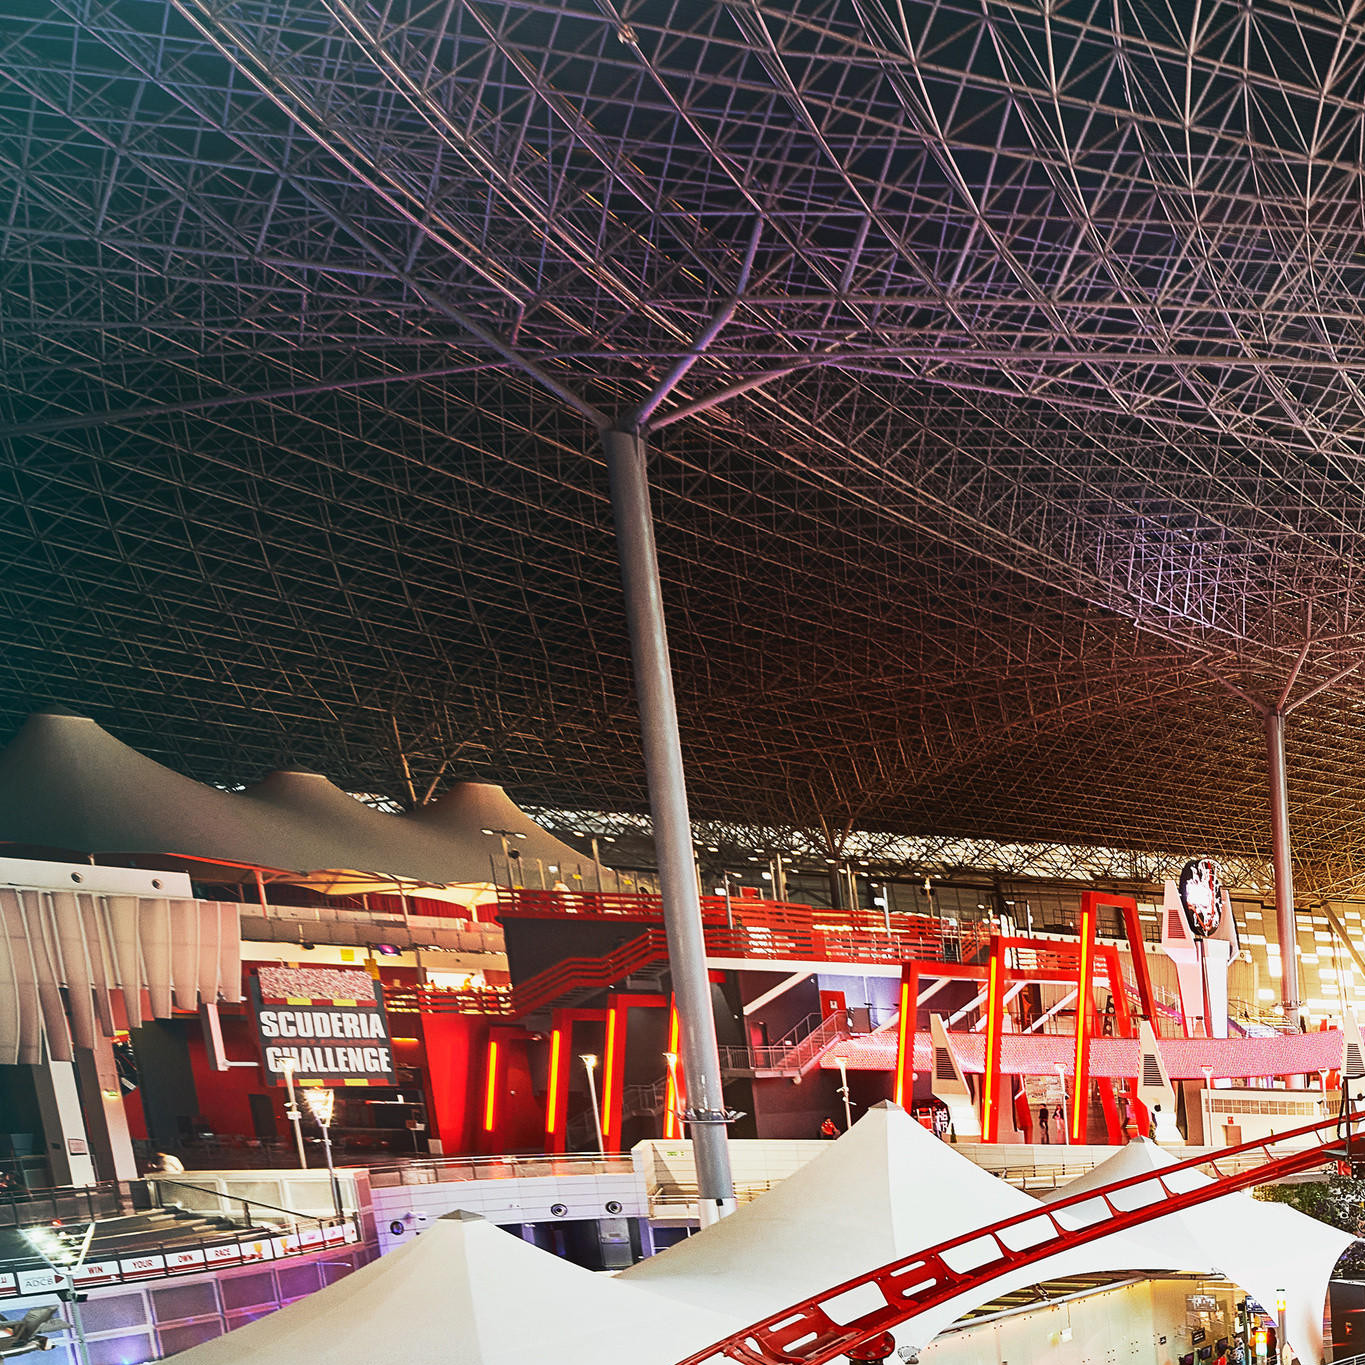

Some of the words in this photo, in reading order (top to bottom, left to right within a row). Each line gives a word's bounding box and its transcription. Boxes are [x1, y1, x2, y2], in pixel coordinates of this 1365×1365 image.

[259, 1011, 386, 1039] SCUDERIA
[265, 1047, 392, 1073] CHALLENGE
[87, 1266, 104, 1275] WIN
[133, 1259, 153, 1269] YOUR
[178, 1254, 193, 1263] OWN
[215, 1248, 231, 1257] RACE
